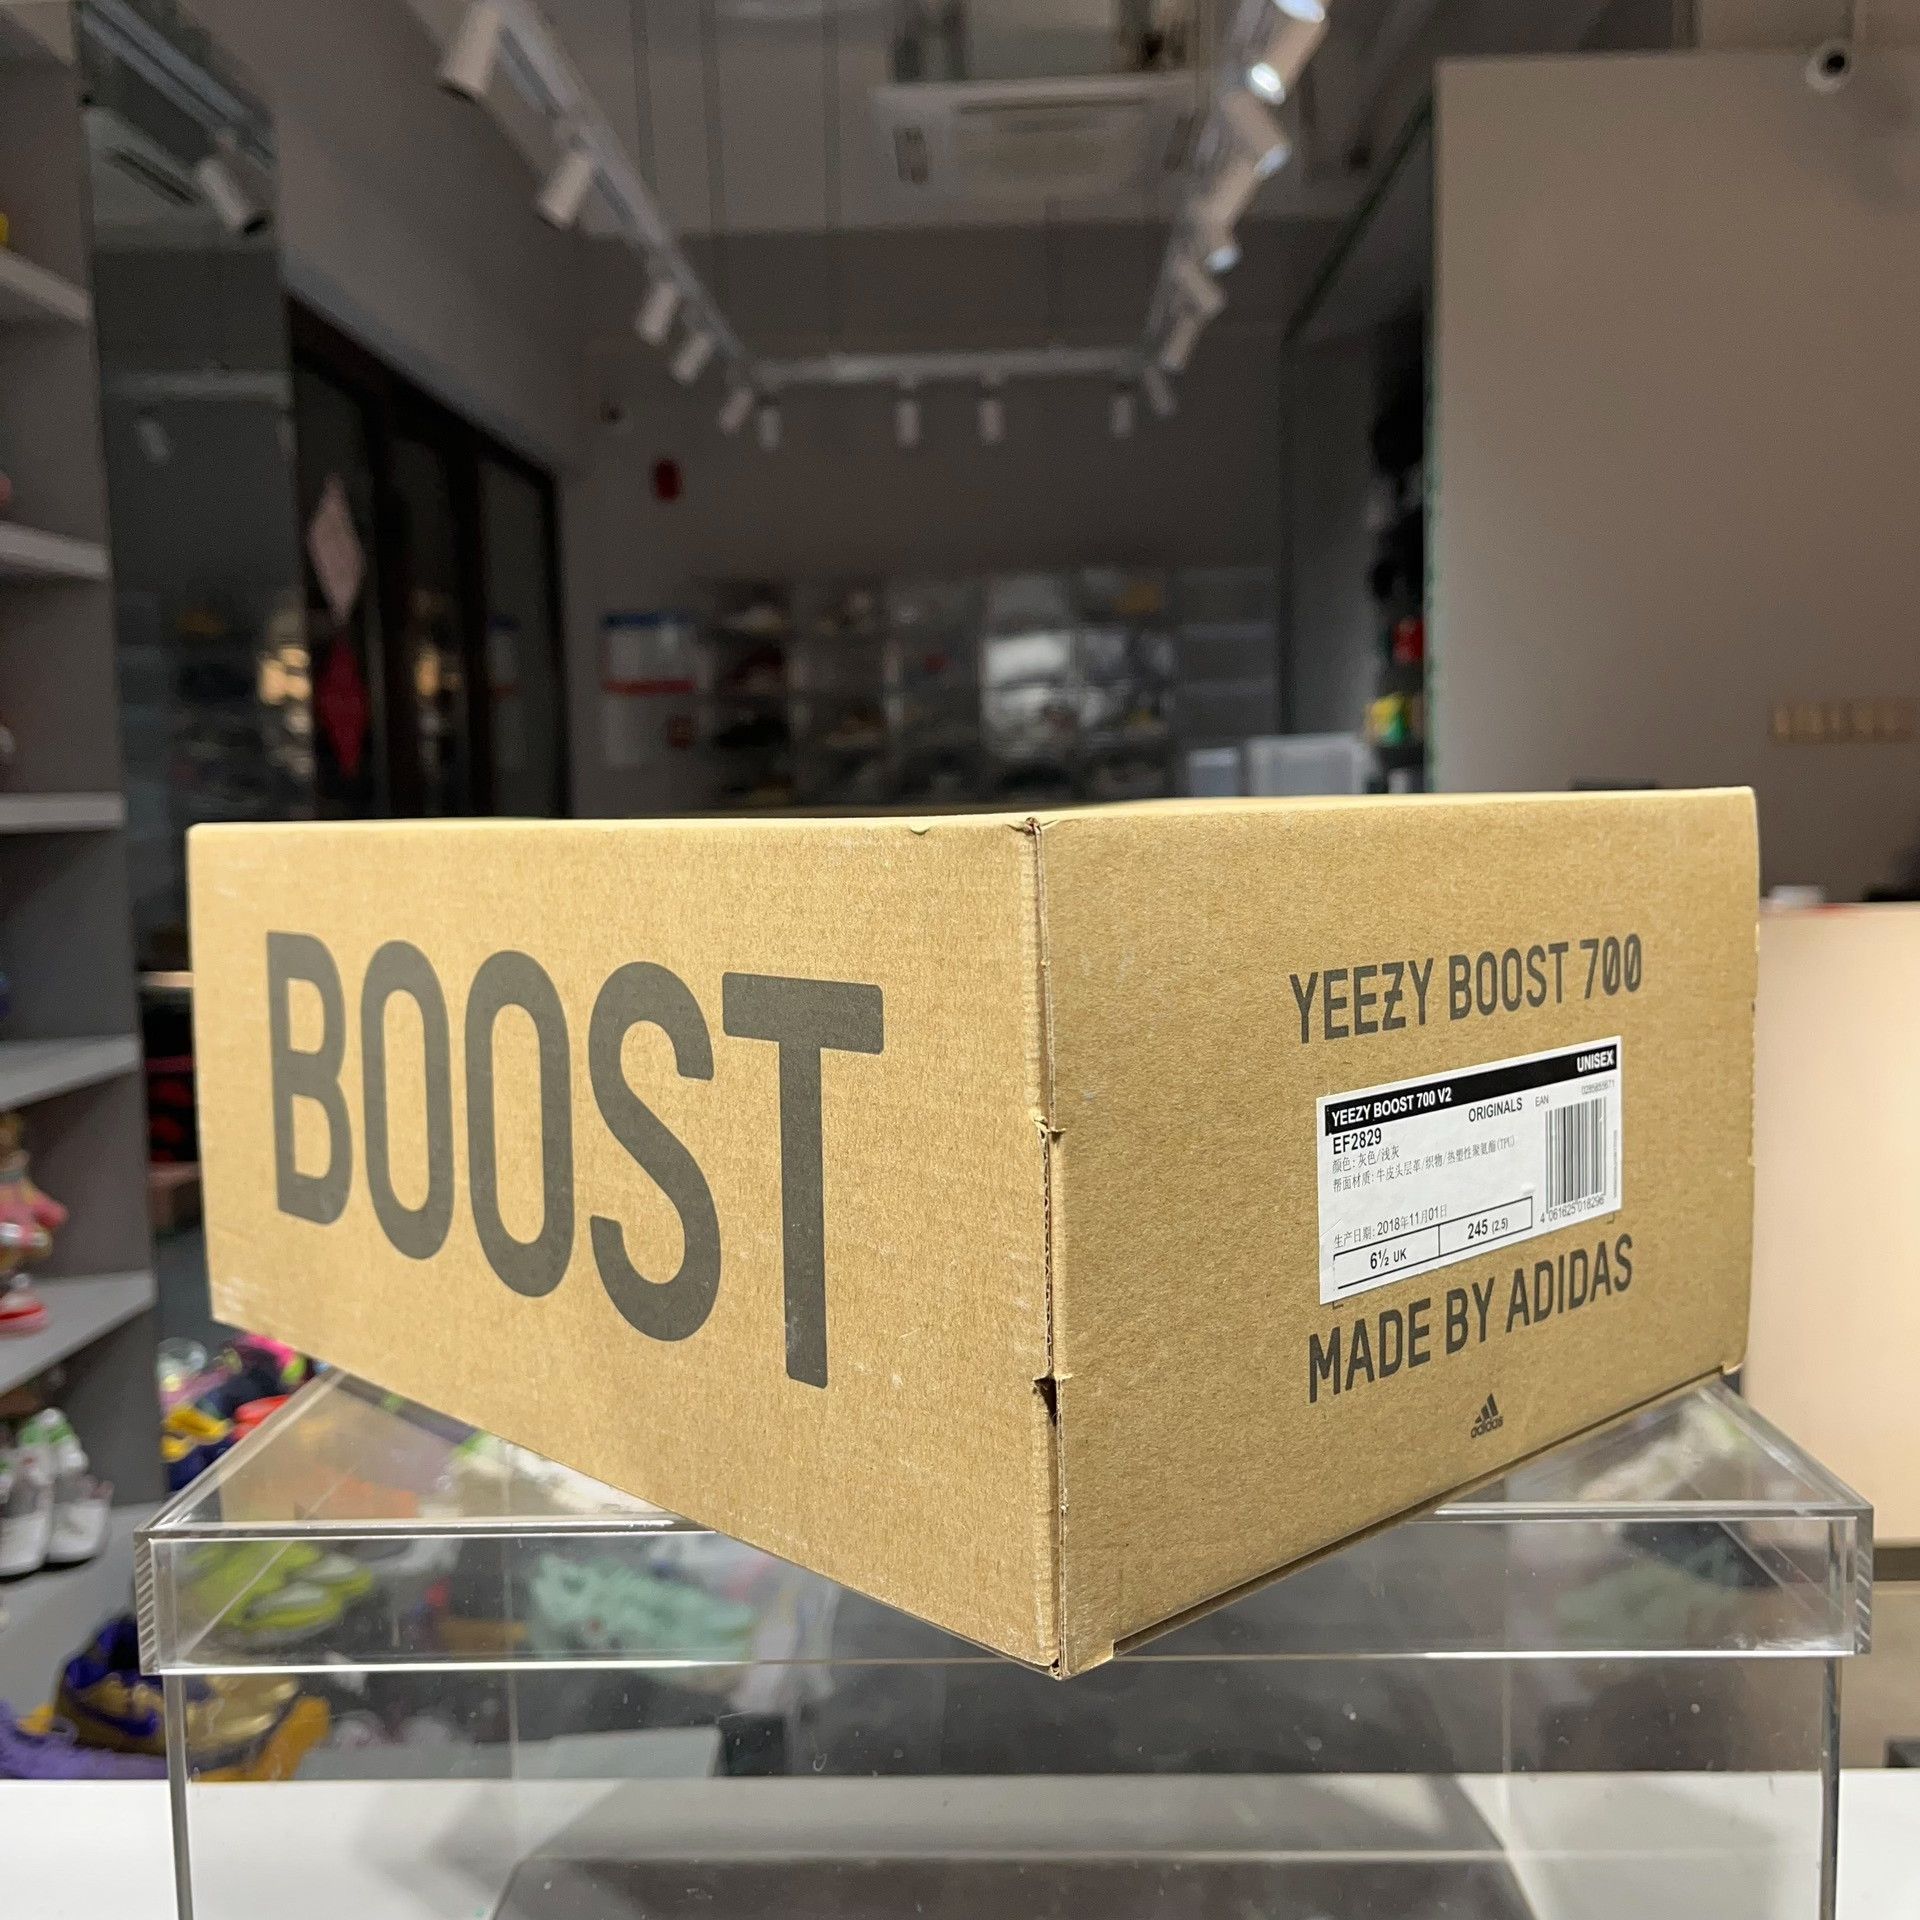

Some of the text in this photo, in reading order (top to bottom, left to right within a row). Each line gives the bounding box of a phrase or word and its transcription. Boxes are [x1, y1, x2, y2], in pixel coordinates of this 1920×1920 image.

[1290, 933, 1642, 1044] YEEZY BOOST 700
[1577, 1049, 1614, 1073] UNISEX
[1332, 1086, 1453, 1127] YEEZY BOOST 700 V2
[1468, 1097, 1523, 1122] ORIGINALS
[1535, 1095, 1549, 1107] EAN
[1333, 1127, 1382, 1155] EF2829
[266, 931, 884, 1389] BOOST
[1467, 1217, 1509, 1240] 245 (2.5)
[1393, 1248, 1407, 1263] UK
[1309, 1233, 1633, 1404] MADE BY ADIDAS
